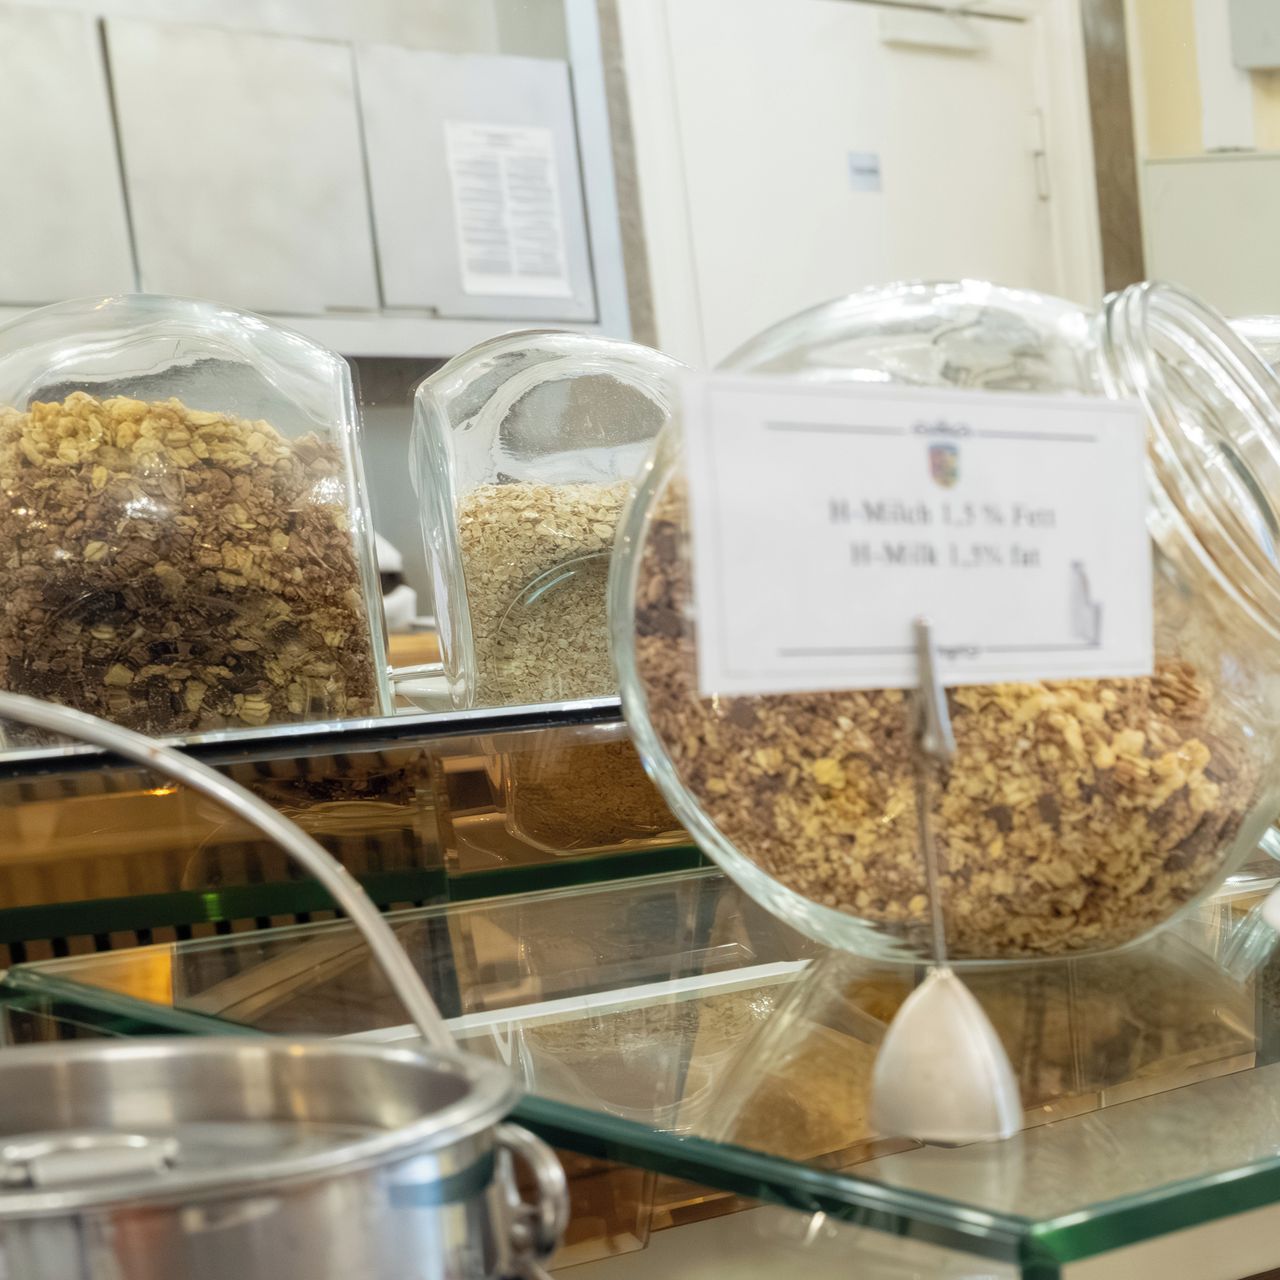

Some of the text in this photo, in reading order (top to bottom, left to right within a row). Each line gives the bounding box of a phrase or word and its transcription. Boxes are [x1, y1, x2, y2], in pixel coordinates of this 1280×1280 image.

[829, 500, 933, 525] H-Milch
[1012, 503, 1056, 527] Fett
[850, 542, 938, 567] H-Milk
[1010, 543, 1041, 567] fat
